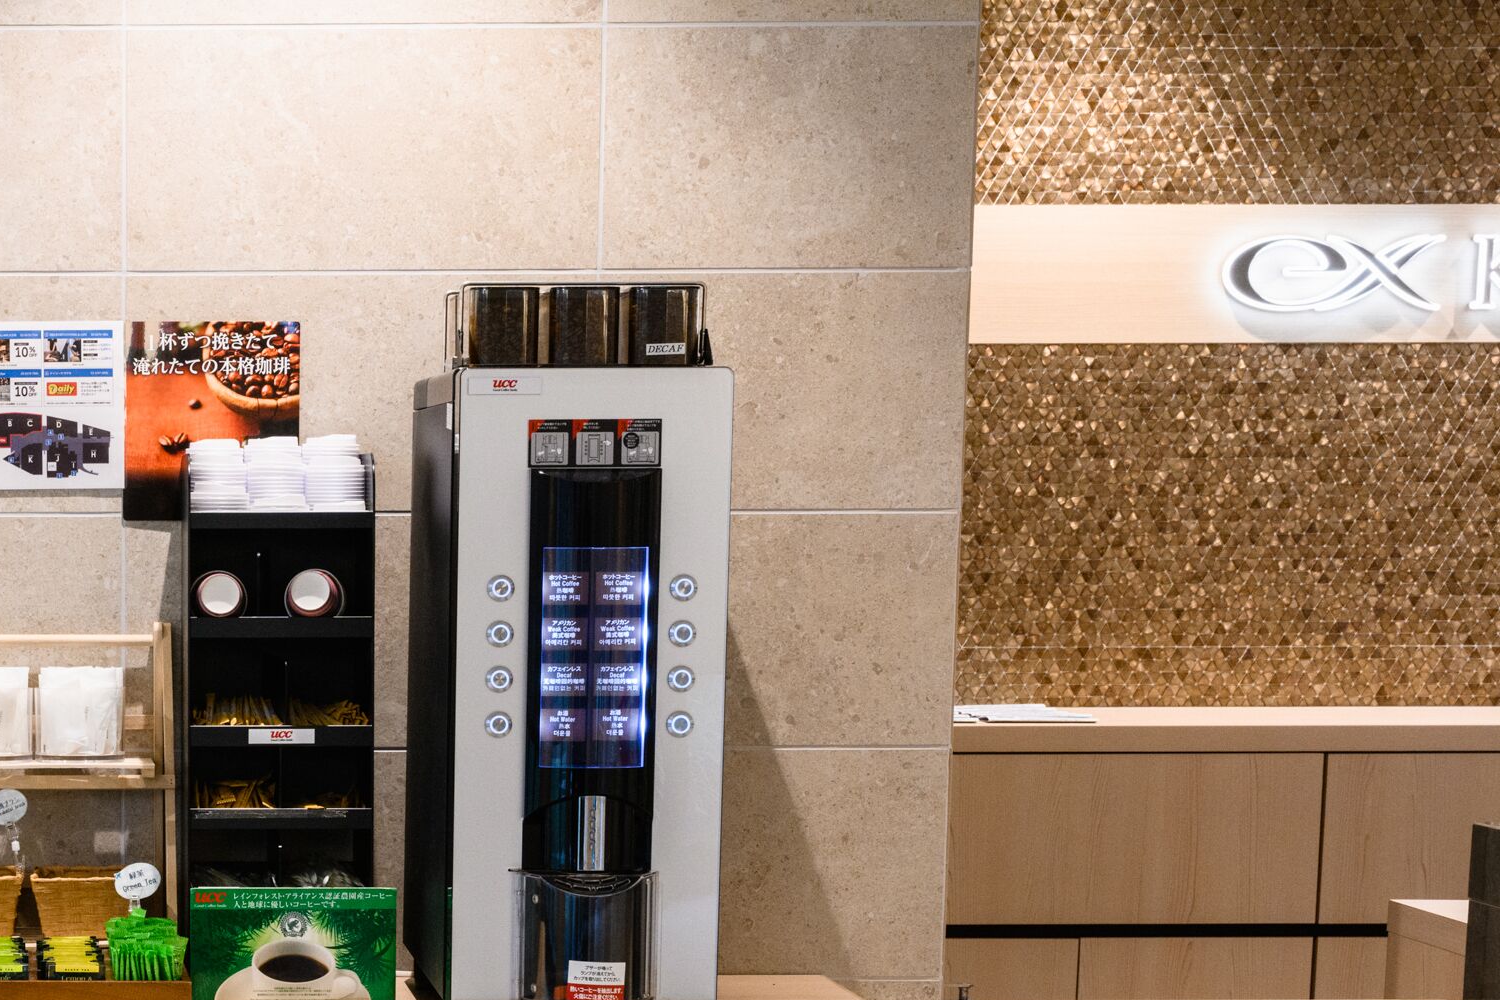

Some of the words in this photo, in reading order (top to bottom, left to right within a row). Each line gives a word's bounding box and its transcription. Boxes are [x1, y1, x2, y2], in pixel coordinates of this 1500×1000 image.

[647, 344, 684, 354] DECAF
[132, 357, 291, 376] 淹れたての本格珈琲
[122, 883, 142, 892] Green
[144, 878, 157, 886] Tea
[233, 892, 393, 900] レインフォレスト・アライアンス認証農園産コーヒー
